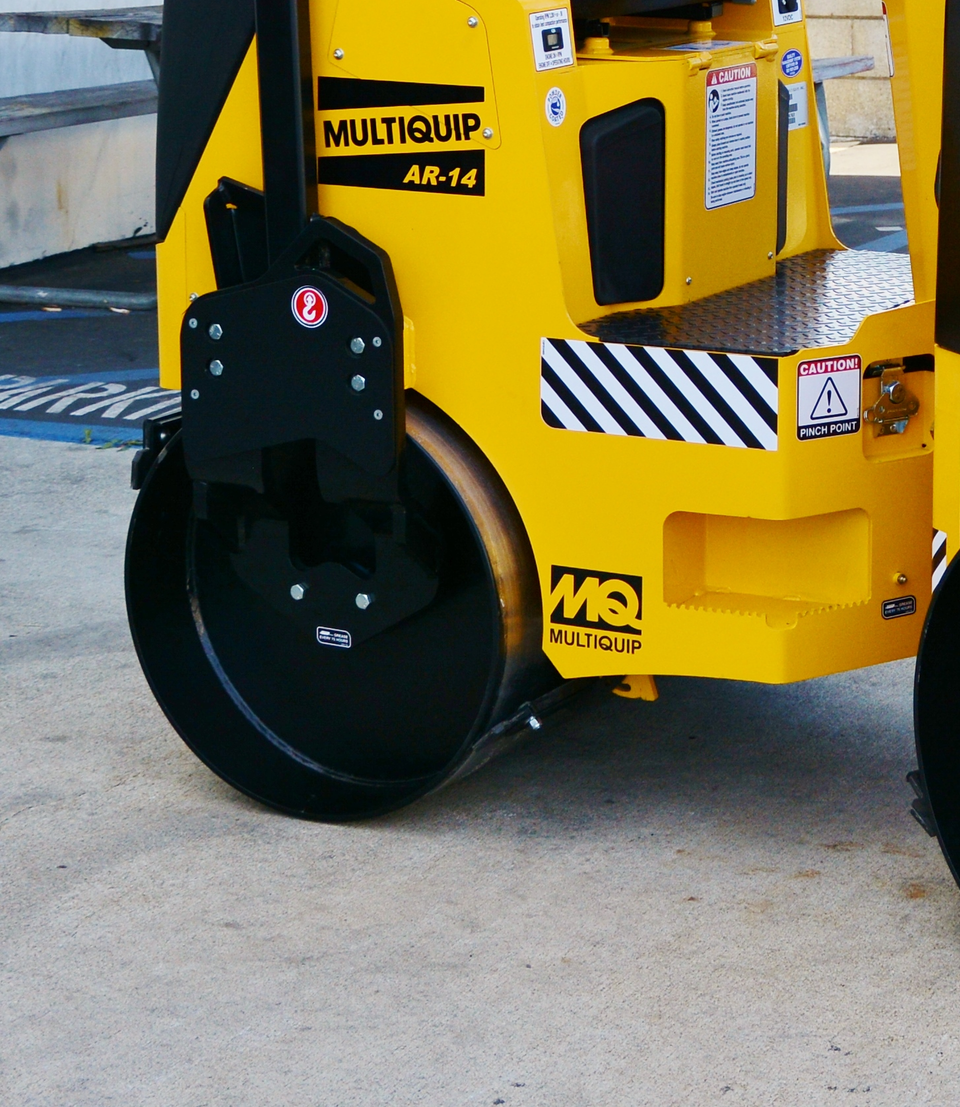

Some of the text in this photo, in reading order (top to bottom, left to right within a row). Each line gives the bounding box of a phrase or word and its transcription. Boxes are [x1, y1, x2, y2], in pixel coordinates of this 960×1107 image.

[719, 66, 751, 83] CAUTION
[323, 113, 481, 148] MULTIQUIP
[402, 164, 478, 188] AR-14
[800, 358, 859, 376] CAUTION!
[800, 421, 858, 438] PINCH POINT
[550, 570, 642, 630] MQ
[549, 628, 642, 655] MULTIQUIP
